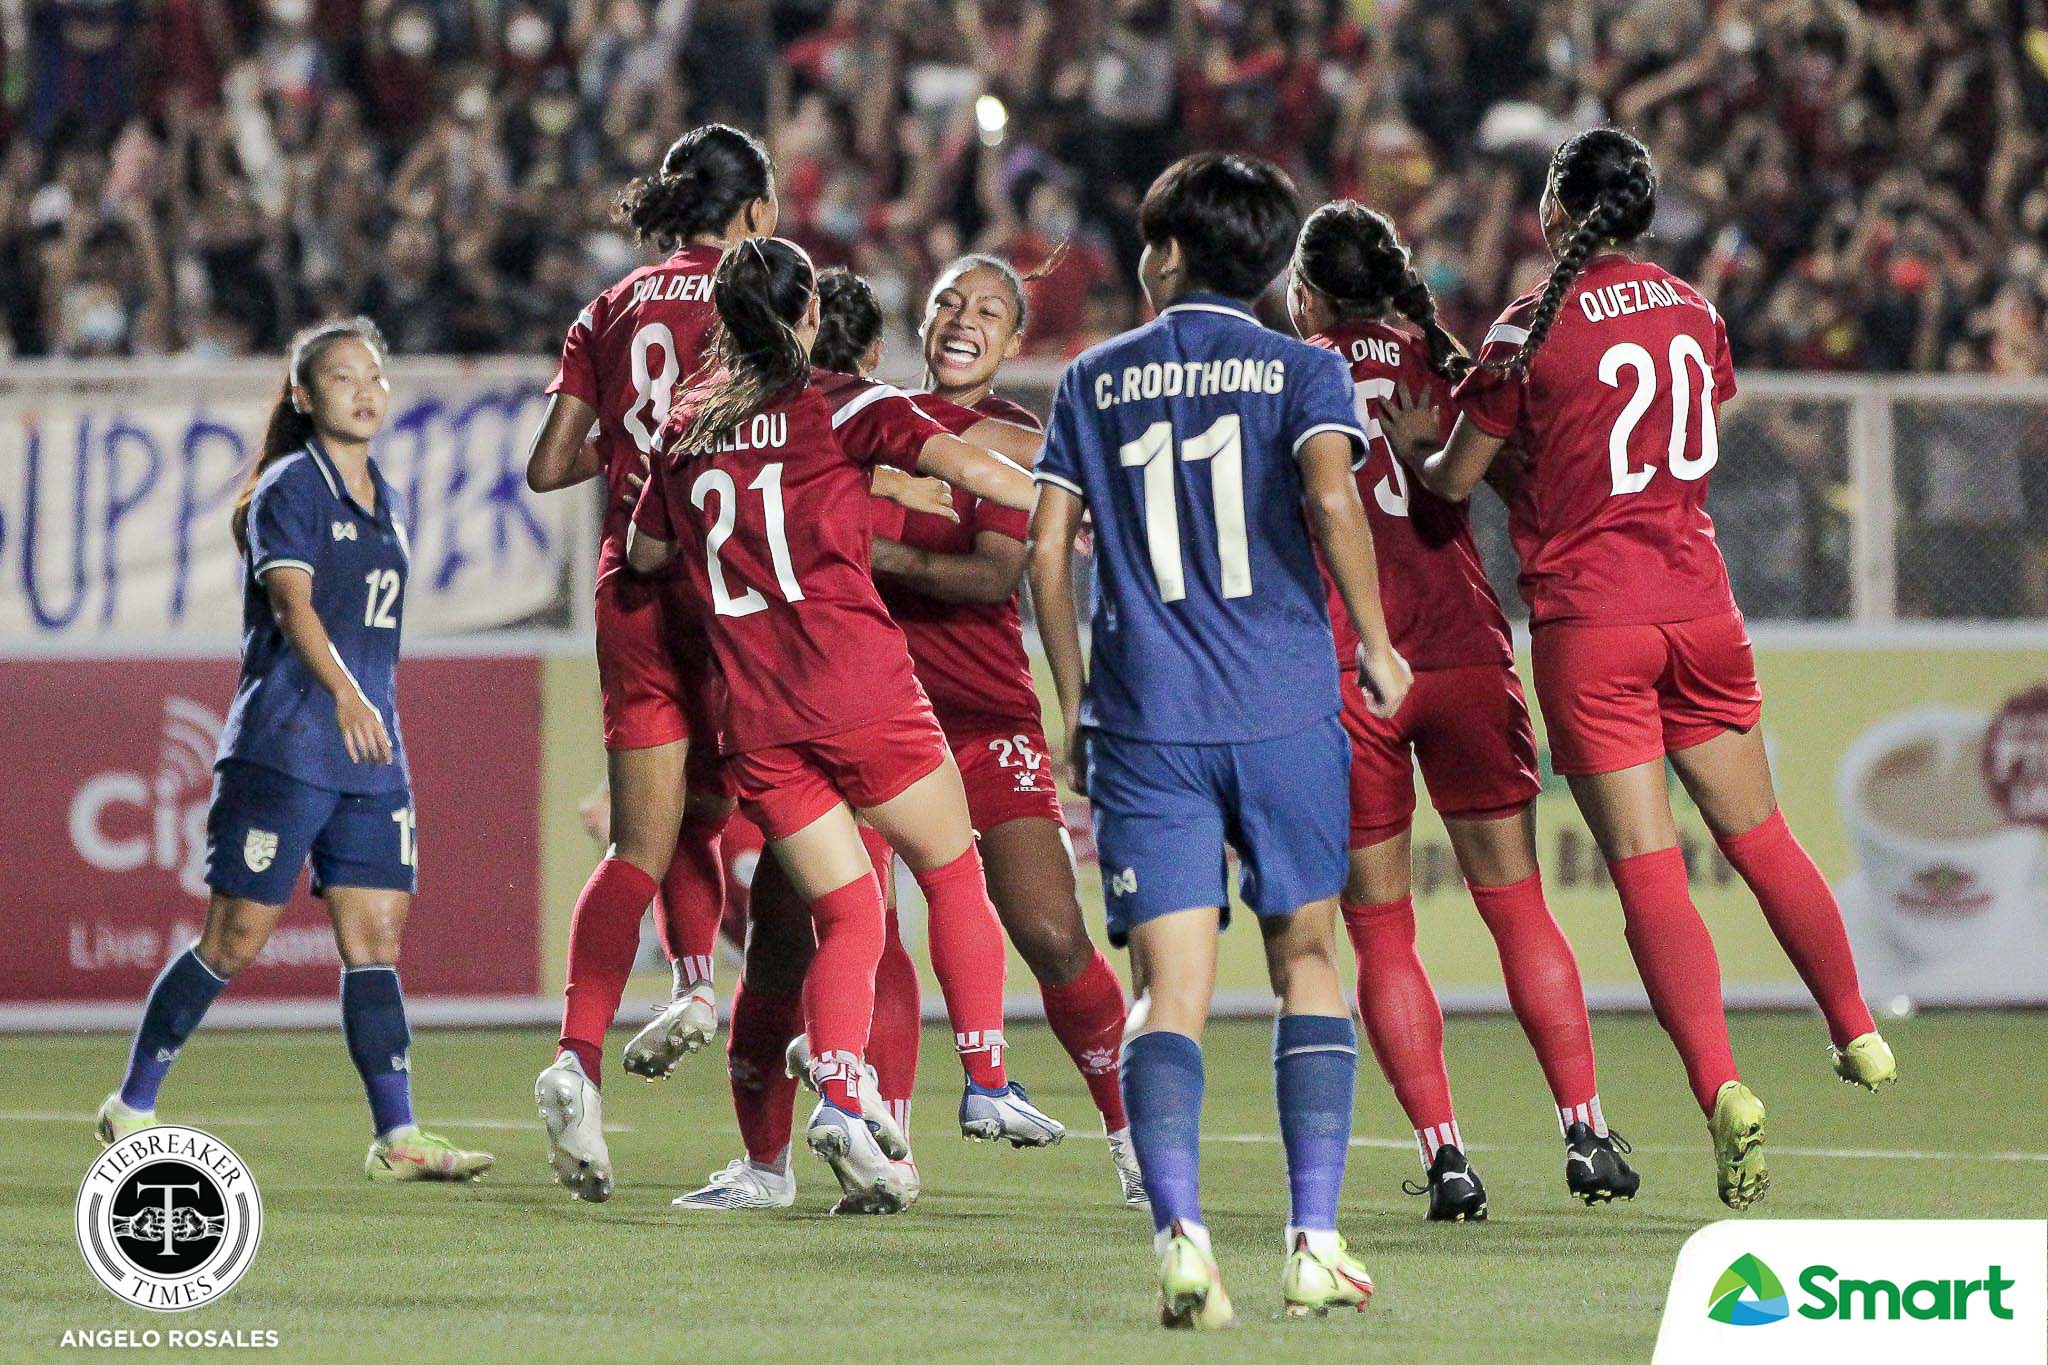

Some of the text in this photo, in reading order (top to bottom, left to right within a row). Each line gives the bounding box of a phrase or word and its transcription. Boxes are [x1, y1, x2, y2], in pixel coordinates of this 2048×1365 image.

[1579, 279, 1685, 323] QUEZADA
[624, 323, 679, 454] 8
[1094, 358, 1285, 410] C.RODTHONG
[1348, 337, 1400, 367] ONG
[1597, 333, 1719, 496] 20
[690, 462, 806, 618] 21
[1119, 413, 1253, 602] 11
[364, 568, 400, 629] 12
